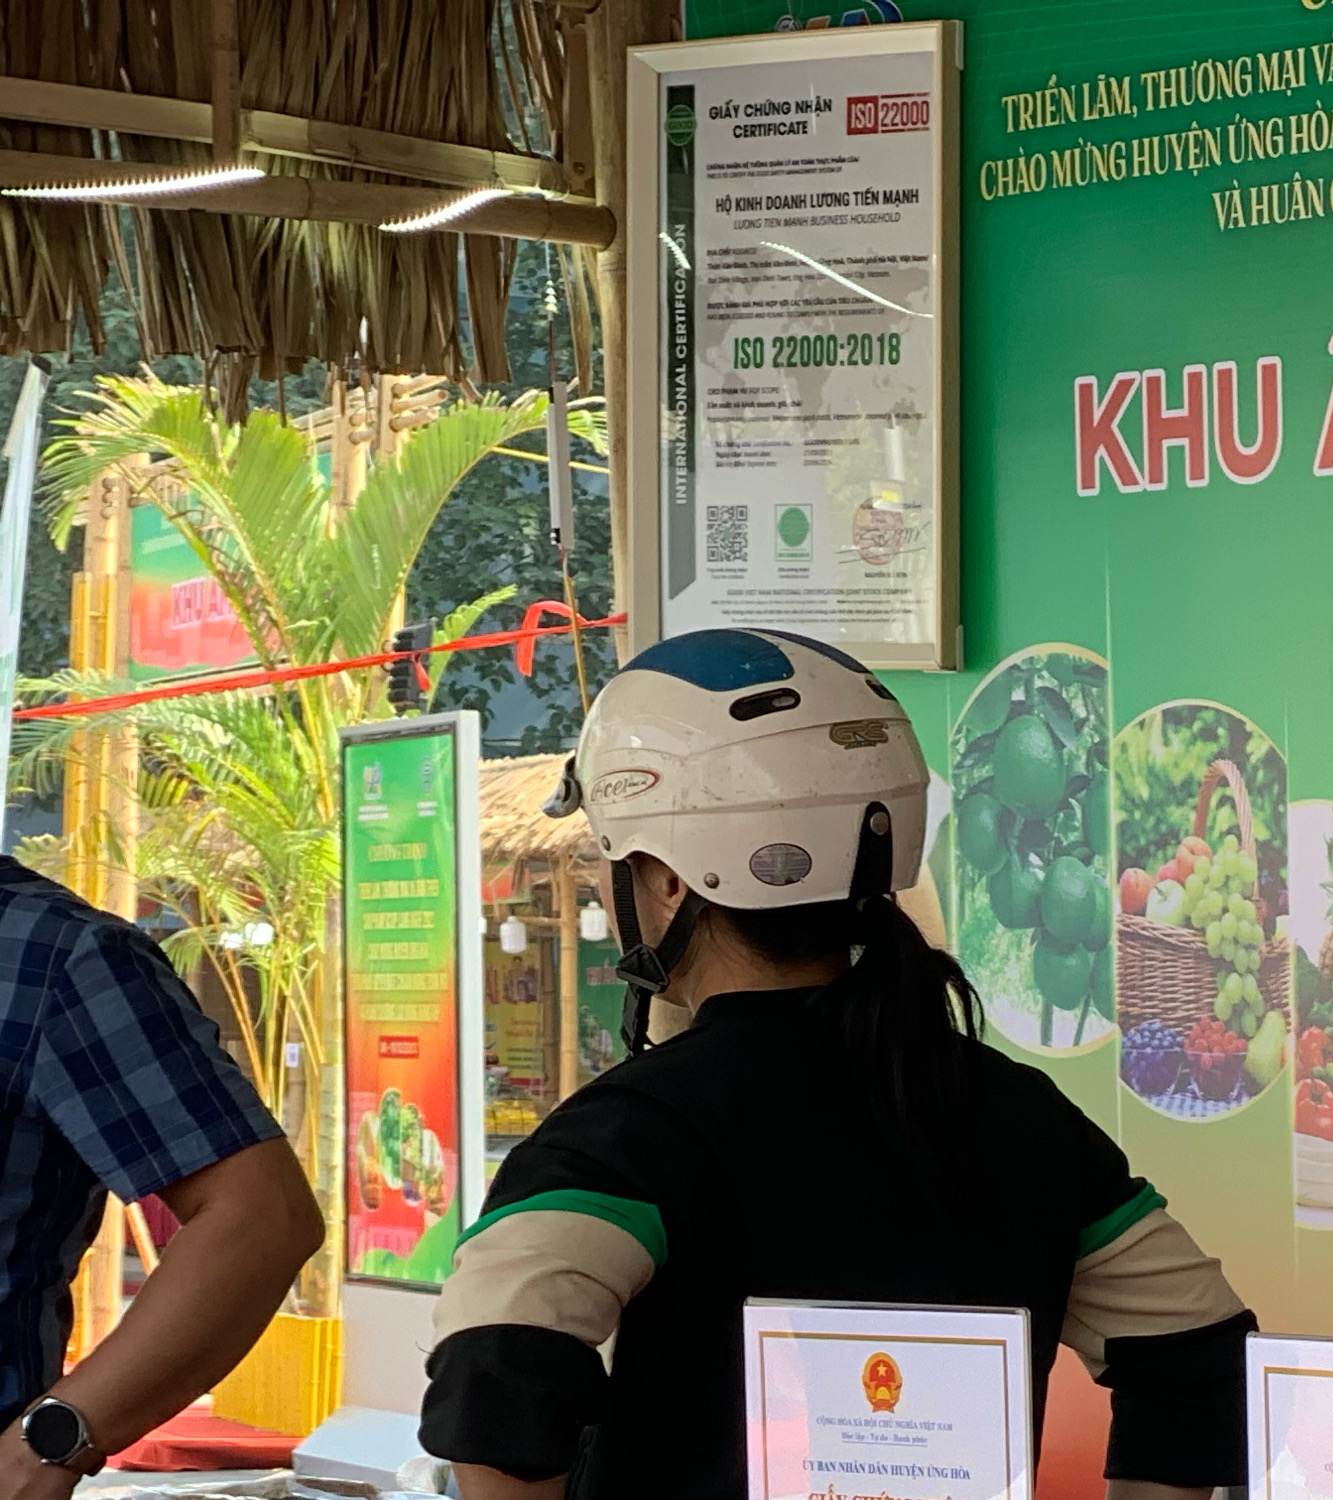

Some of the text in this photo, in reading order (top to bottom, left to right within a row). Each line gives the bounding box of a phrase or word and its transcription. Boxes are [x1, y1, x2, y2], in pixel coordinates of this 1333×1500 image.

[1141, 56, 1252, 112] THƯƠNG
[1257, 47, 1306, 97] MẠI
[709, 96, 832, 120] GIẤY CHỨNG NHẬN
[850, 101, 930, 129] ISO 22000
[733, 121, 808, 139] CERTIFICATE
[980, 147, 1047, 201] CHÀO
[1051, 137, 1127, 189] MỪNG
[1131, 121, 1222, 177] HUYỆN
[1228, 113, 1284, 164] ỨNG
[716, 187, 920, 216] HỘ KINH DOANH LƯƠNG TIẾN MẠNH
[1211, 180, 1247, 233] VÀ
[1251, 173, 1325, 226] HUÂN
[733, 213, 901, 230] LUONG TIEN MANH BUSINESS HOUSEHOLD
[733, 332, 901, 369] ISO 22000:2018
[674, 363, 688, 505] INTERNATIONAL
[1074, 355, 1284, 497] KHU
